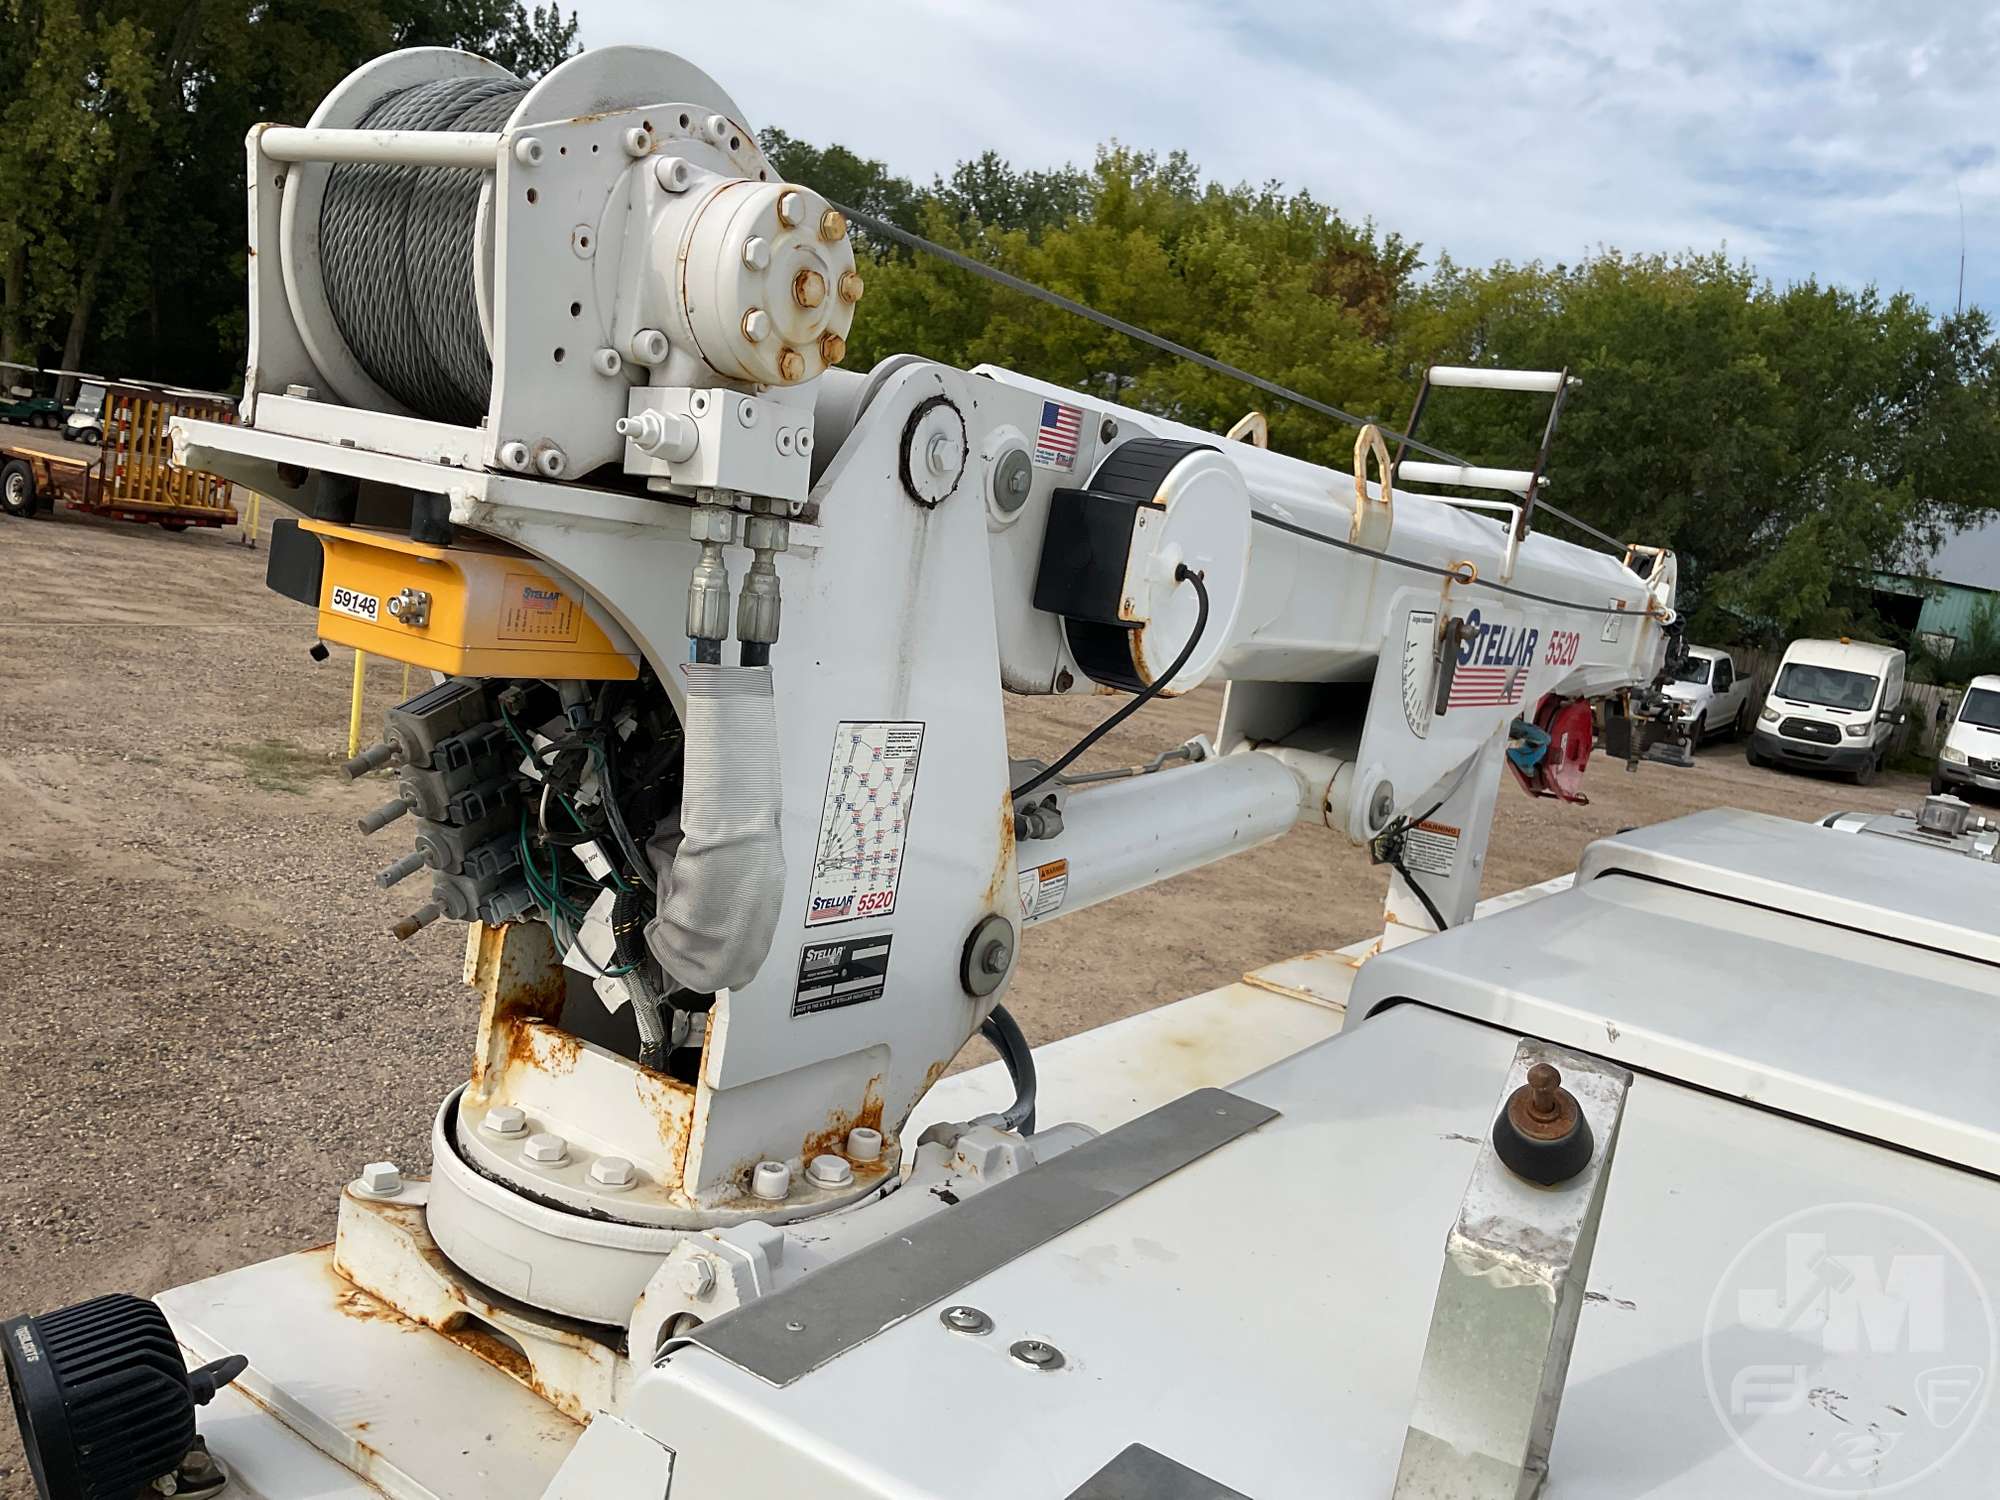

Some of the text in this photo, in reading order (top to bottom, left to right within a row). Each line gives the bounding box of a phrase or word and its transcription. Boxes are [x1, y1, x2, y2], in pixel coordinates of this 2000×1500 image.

[333, 588, 377, 615] 59148
[522, 587, 560, 601] STELLAR
[1457, 608, 1580, 667] STELLAR 5520
[812, 891, 893, 911] STELLAR 5520
[806, 946, 843, 961] STELLAR
